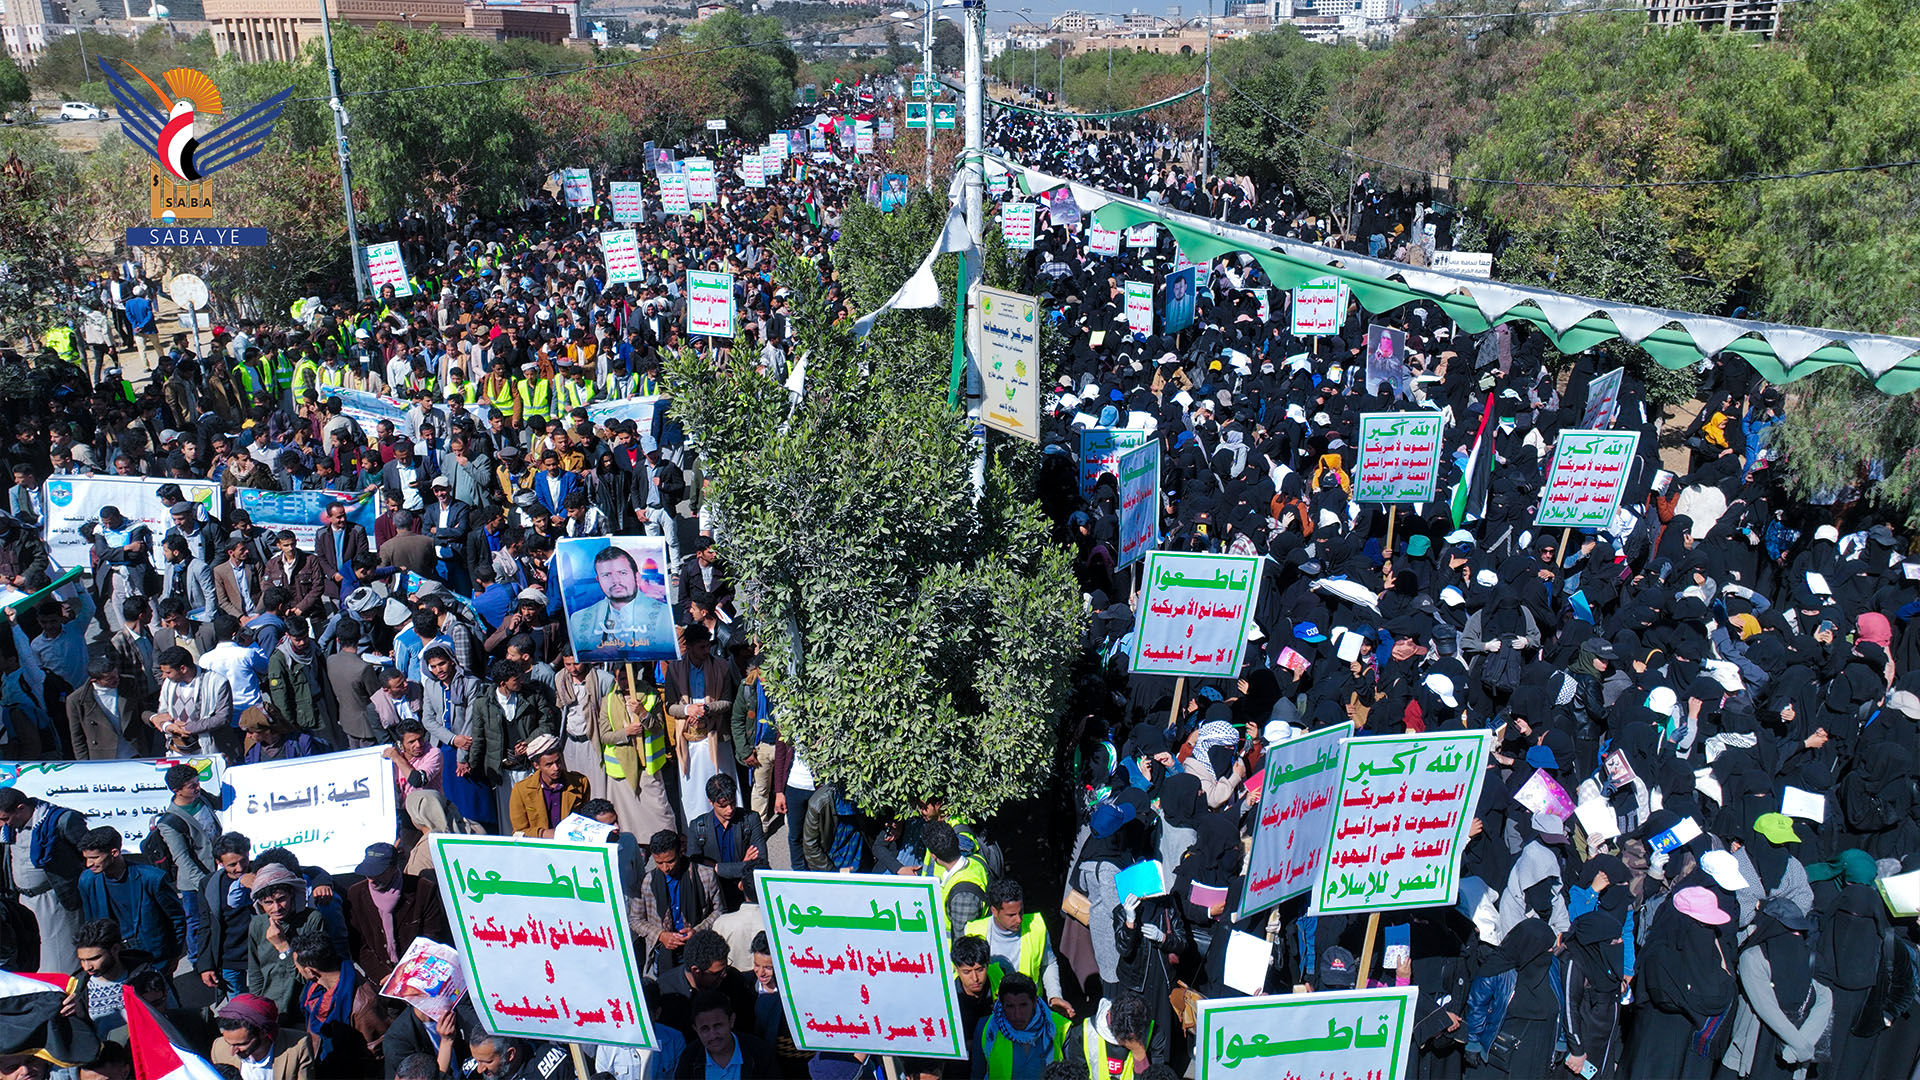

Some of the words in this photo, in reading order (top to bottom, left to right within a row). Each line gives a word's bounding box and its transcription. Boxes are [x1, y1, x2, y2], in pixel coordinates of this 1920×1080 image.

[691, 277, 728, 289] قاطعوا
[983, 321, 1010, 338] مبيعات
[1011, 327, 1033, 344] مركز
[1368, 419, 1409, 441] أكبر
[1410, 422, 1436, 436] الله
[1087, 434, 1119, 453] أكبر
[1366, 440, 1401, 454] لأمريكا
[1404, 442, 1433, 453] الموت
[1561, 438, 1604, 458] أكبر
[1603, 440, 1629, 455] الله
[1364, 456, 1399, 469] لإسرائيل
[1402, 458, 1431, 468] الموت
[1558, 459, 1593, 472] لأمريكا
[1595, 462, 1623, 473] الموت
[1362, 472, 1387, 483] اليهود
[1389, 472, 1403, 482] على
[1407, 472, 1429, 480] اللعنة
[1553, 476, 1589, 489] لإسرائيل
[1590, 478, 1619, 489] الموت
[1360, 484, 1394, 498] للإسلام
[1396, 483, 1428, 498] النصر
[1548, 493, 1574, 504] اليهود
[1575, 493, 1589, 504] على
[1592, 493, 1615, 503] اللعنة
[1543, 506, 1578, 522] للإسلام
[1578, 506, 1610, 522] النصر
[1155, 564, 1248, 591] قاطعوا
[1150, 597, 1198, 619] الأمريكية
[1199, 601, 1242, 622] البضائع
[594, 620, 648, 638] سيد
[1186, 624, 1193, 638] و
[597, 637, 625, 648] والفعل
[627, 637, 650, 647] القول
[1143, 643, 1233, 666] الإسرائيلية
[1346, 743, 1428, 786] أكبر
[1426, 745, 1473, 773] الله
[46, 784, 88, 796] فلسطين
[93, 784, 126, 793] معاناة
[1343, 781, 1408, 810] لأمريكا
[1411, 783, 1465, 806] الموت
[116, 808, 127, 816] ما
[1261, 795, 1301, 828] الأمريكية
[1299, 786, 1333, 819] البضائع
[1337, 813, 1402, 840] لإسرائيل
[1404, 812, 1457, 834] الموت
[124, 830, 143, 840] غزة
[1286, 830, 1294, 850] و
[1332, 844, 1377, 869] اليهود
[1380, 843, 1406, 867] على
[1410, 839, 1450, 858] اللعنة
[1250, 847, 1320, 894] الإسرائيلية
[453, 858, 605, 904] قاطعوا
[1326, 870, 1389, 904] للإسلام
[1391, 863, 1446, 900] النصر
[775, 894, 928, 935] قاطعوا
[470, 914, 546, 949] الأمريكية
[549, 919, 615, 952] البضائع
[788, 944, 864, 975] الأمريكية
[866, 948, 934, 978] البضائع
[545, 960, 555, 984] و
[860, 984, 870, 1005] و
[491, 993, 635, 1028] الإسرائيلية
[804, 1012, 947, 1042] الإسرائيلية
[1216, 1014, 1389, 1069] قاطعوا
